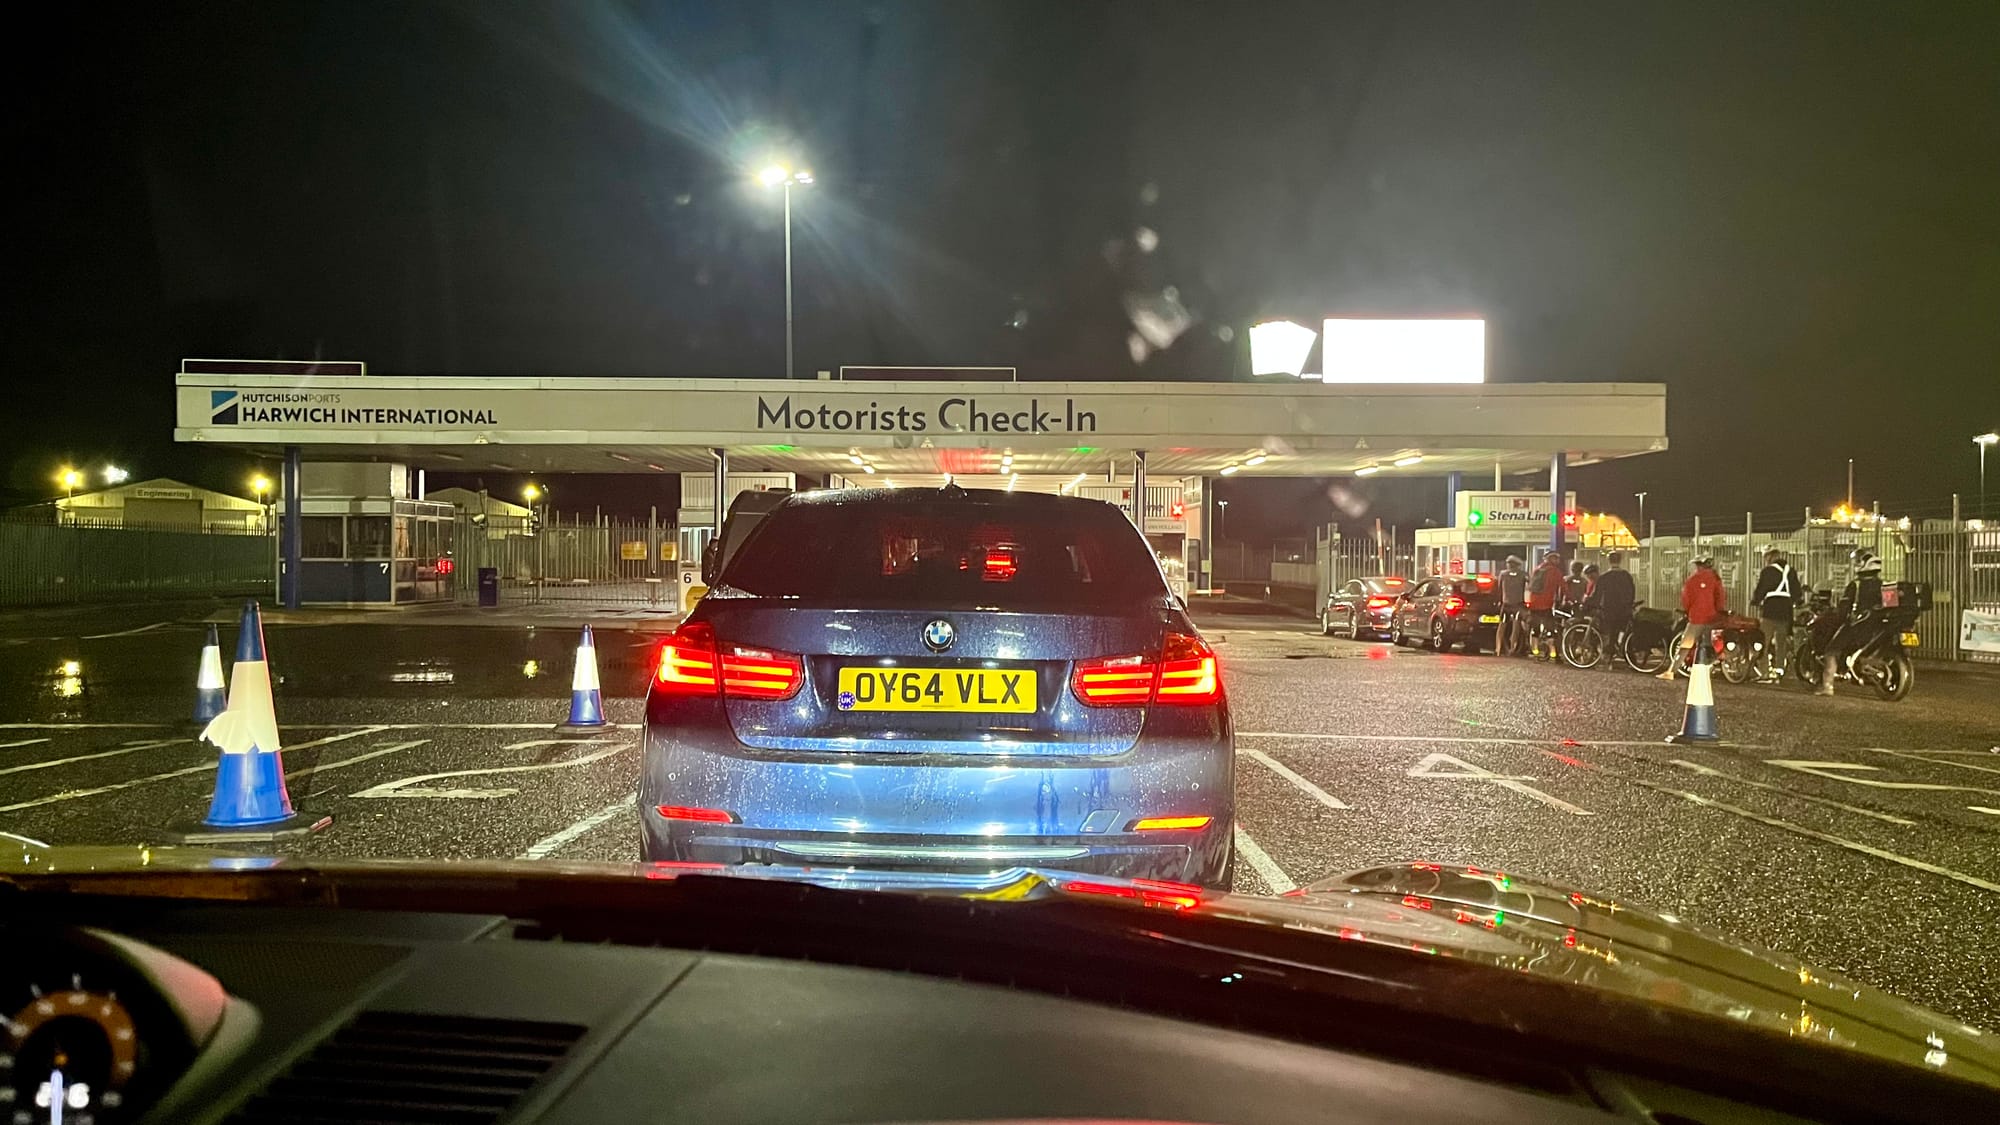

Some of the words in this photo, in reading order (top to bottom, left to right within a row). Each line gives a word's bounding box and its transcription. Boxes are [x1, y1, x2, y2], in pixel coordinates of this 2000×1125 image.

[243, 407, 336, 423] HARWICH
[341, 408, 498, 425] INTERNATIONAL
[757, 395, 927, 432] Motorists
[938, 398, 1097, 433] Check-In
[379, 562, 390, 574] 7
[683, 572, 692, 584] 6
[855, 672, 944, 704] OY64
[956, 673, 1021, 705] VLX
